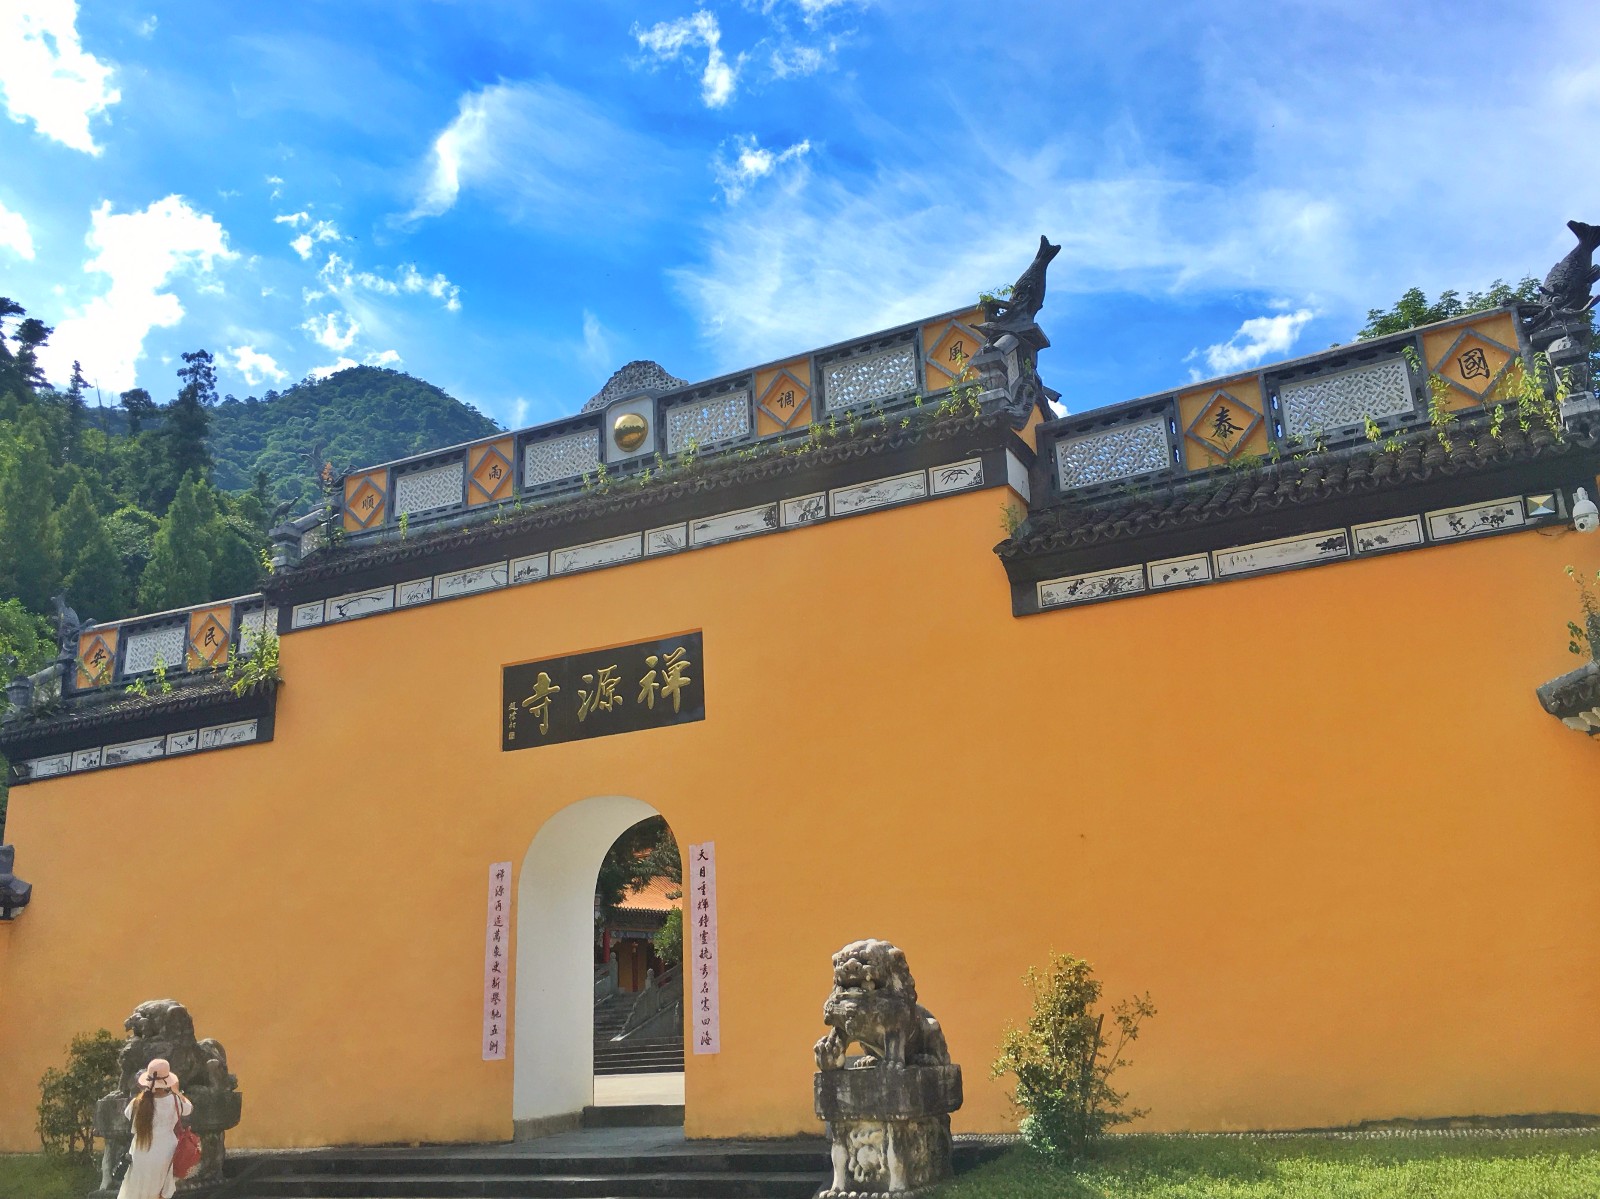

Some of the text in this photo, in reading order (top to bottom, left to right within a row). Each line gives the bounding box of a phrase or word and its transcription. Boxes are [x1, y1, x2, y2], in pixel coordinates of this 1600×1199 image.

[1457, 347, 1491, 380] 國
[1211, 405, 1244, 439] 泰
[488, 464, 502, 481] 雨
[204, 626, 219, 647] 民
[90, 648, 107, 669] 安
